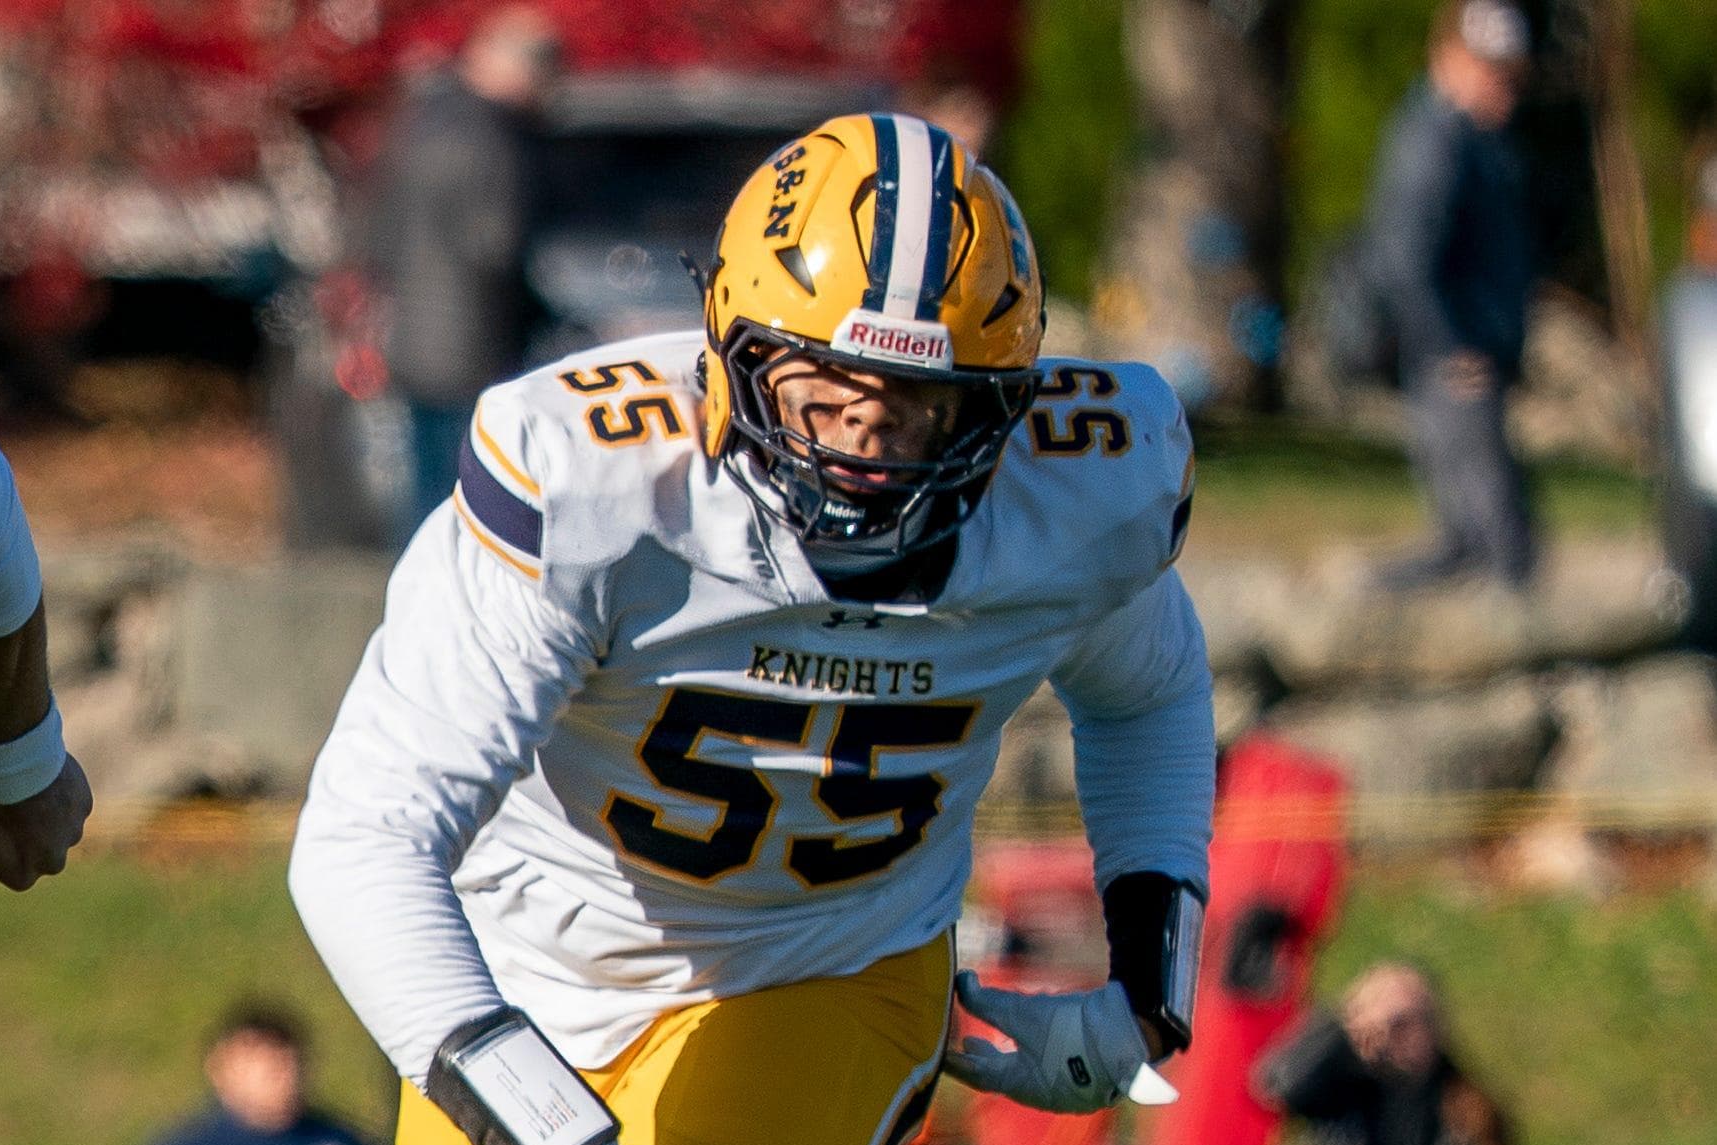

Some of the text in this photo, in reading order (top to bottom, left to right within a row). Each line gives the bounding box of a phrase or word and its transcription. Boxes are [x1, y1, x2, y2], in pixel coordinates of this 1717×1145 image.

[849, 322, 946, 358] Riddell
[557, 360, 689, 449] 55
[1026, 366, 1132, 458] 55
[746, 645, 933, 695] KNIGHTS
[600, 687, 982, 890] 55
